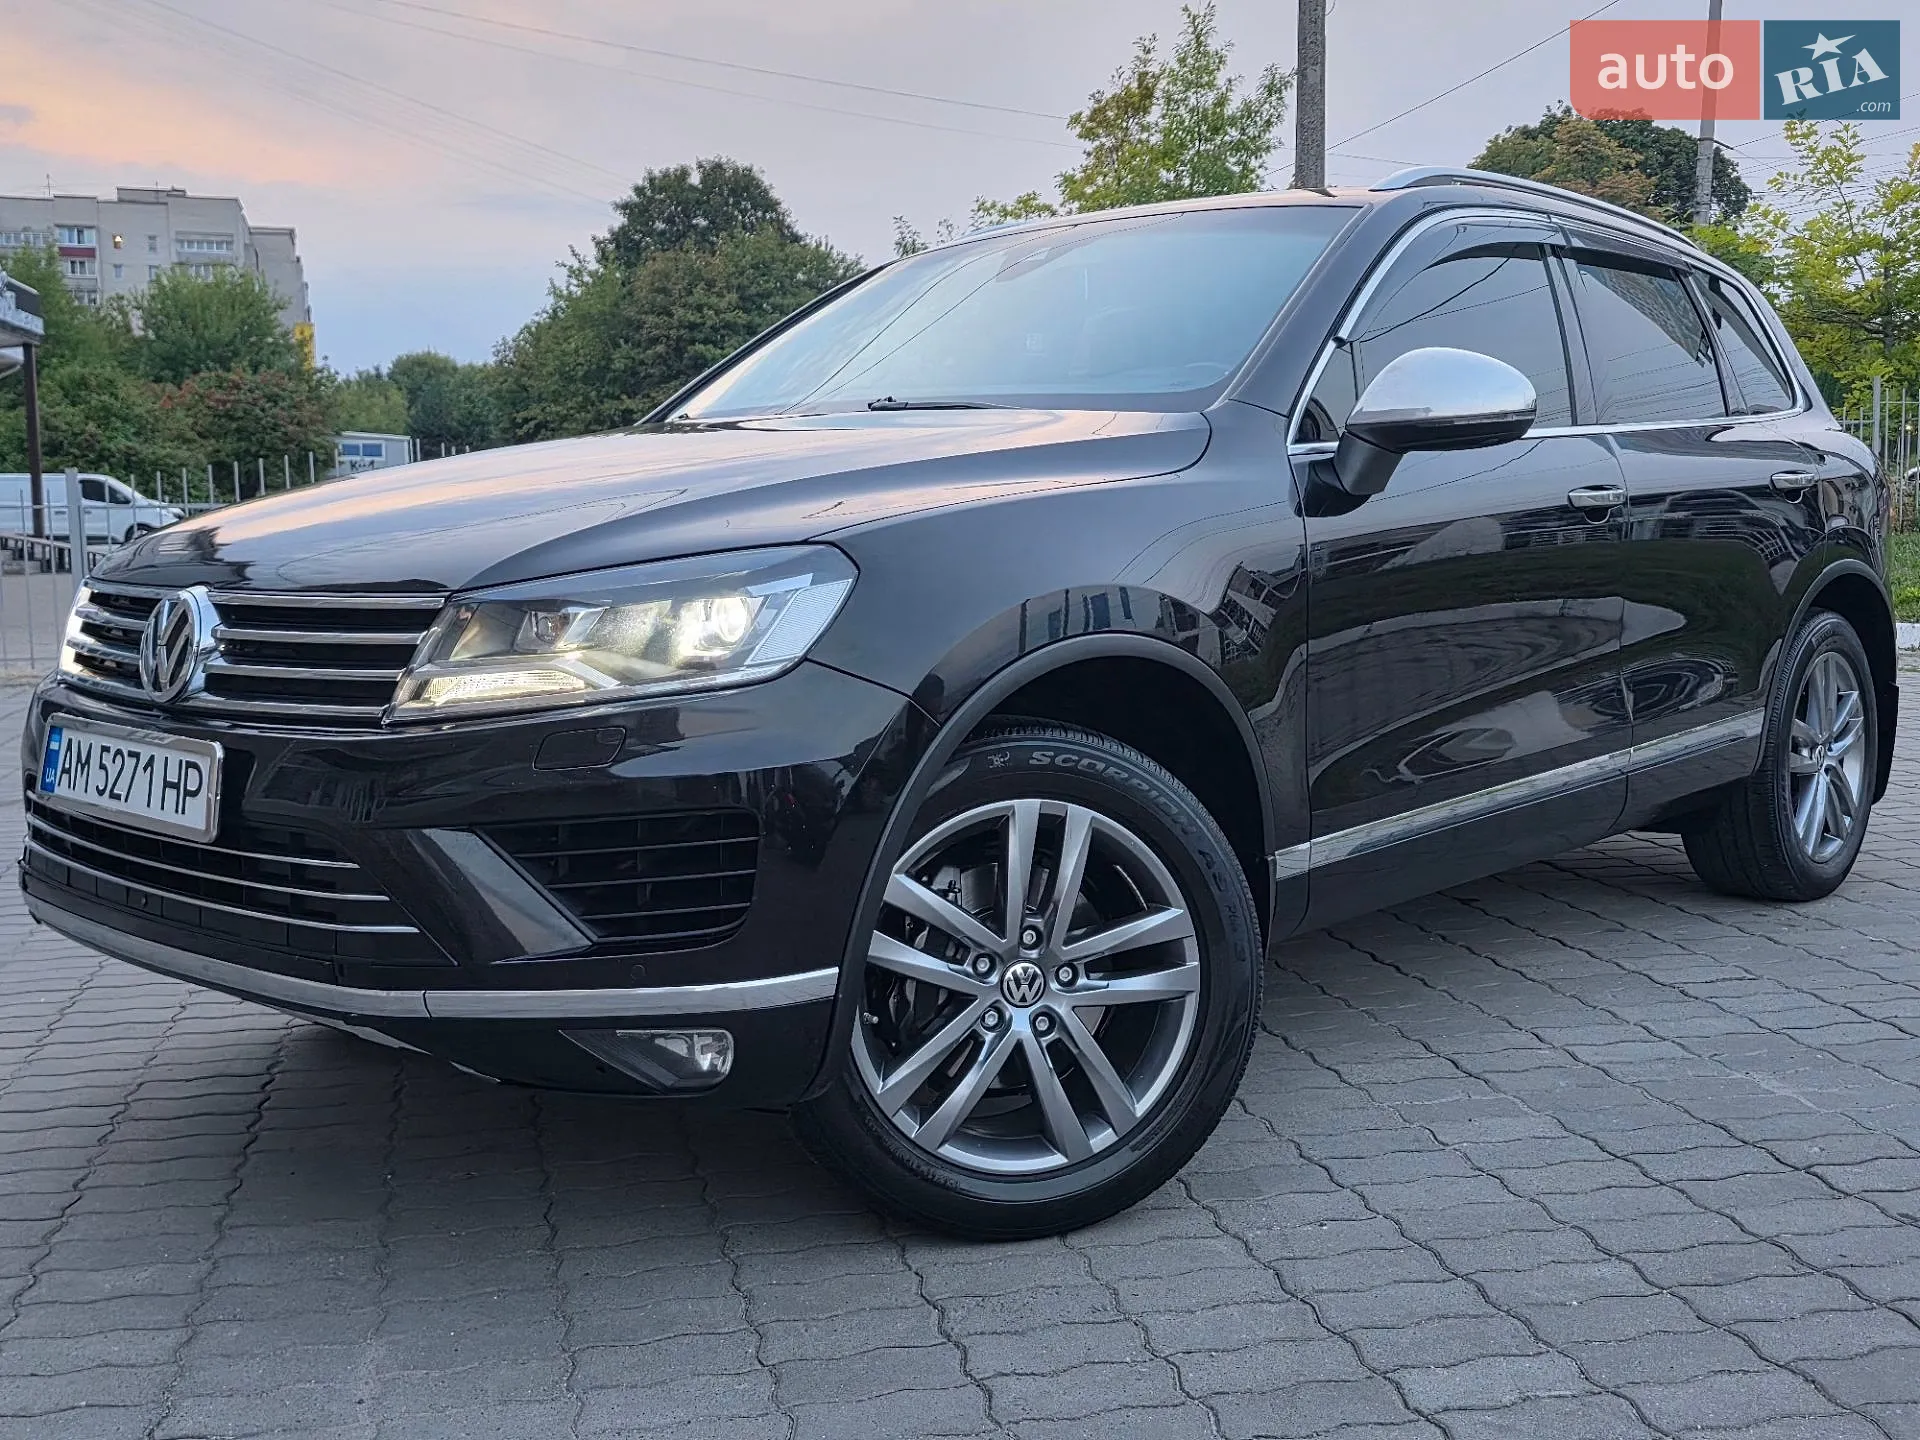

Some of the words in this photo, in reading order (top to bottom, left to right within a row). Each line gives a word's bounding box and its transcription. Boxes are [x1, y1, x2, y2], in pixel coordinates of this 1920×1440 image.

[45, 767, 56, 785] UA
[57, 737, 93, 794] AM
[95, 743, 156, 808] 5271
[160, 755, 204, 815] HP
[1028, 750, 1198, 836] SCORPION
[1003, 961, 1044, 1006] VW
